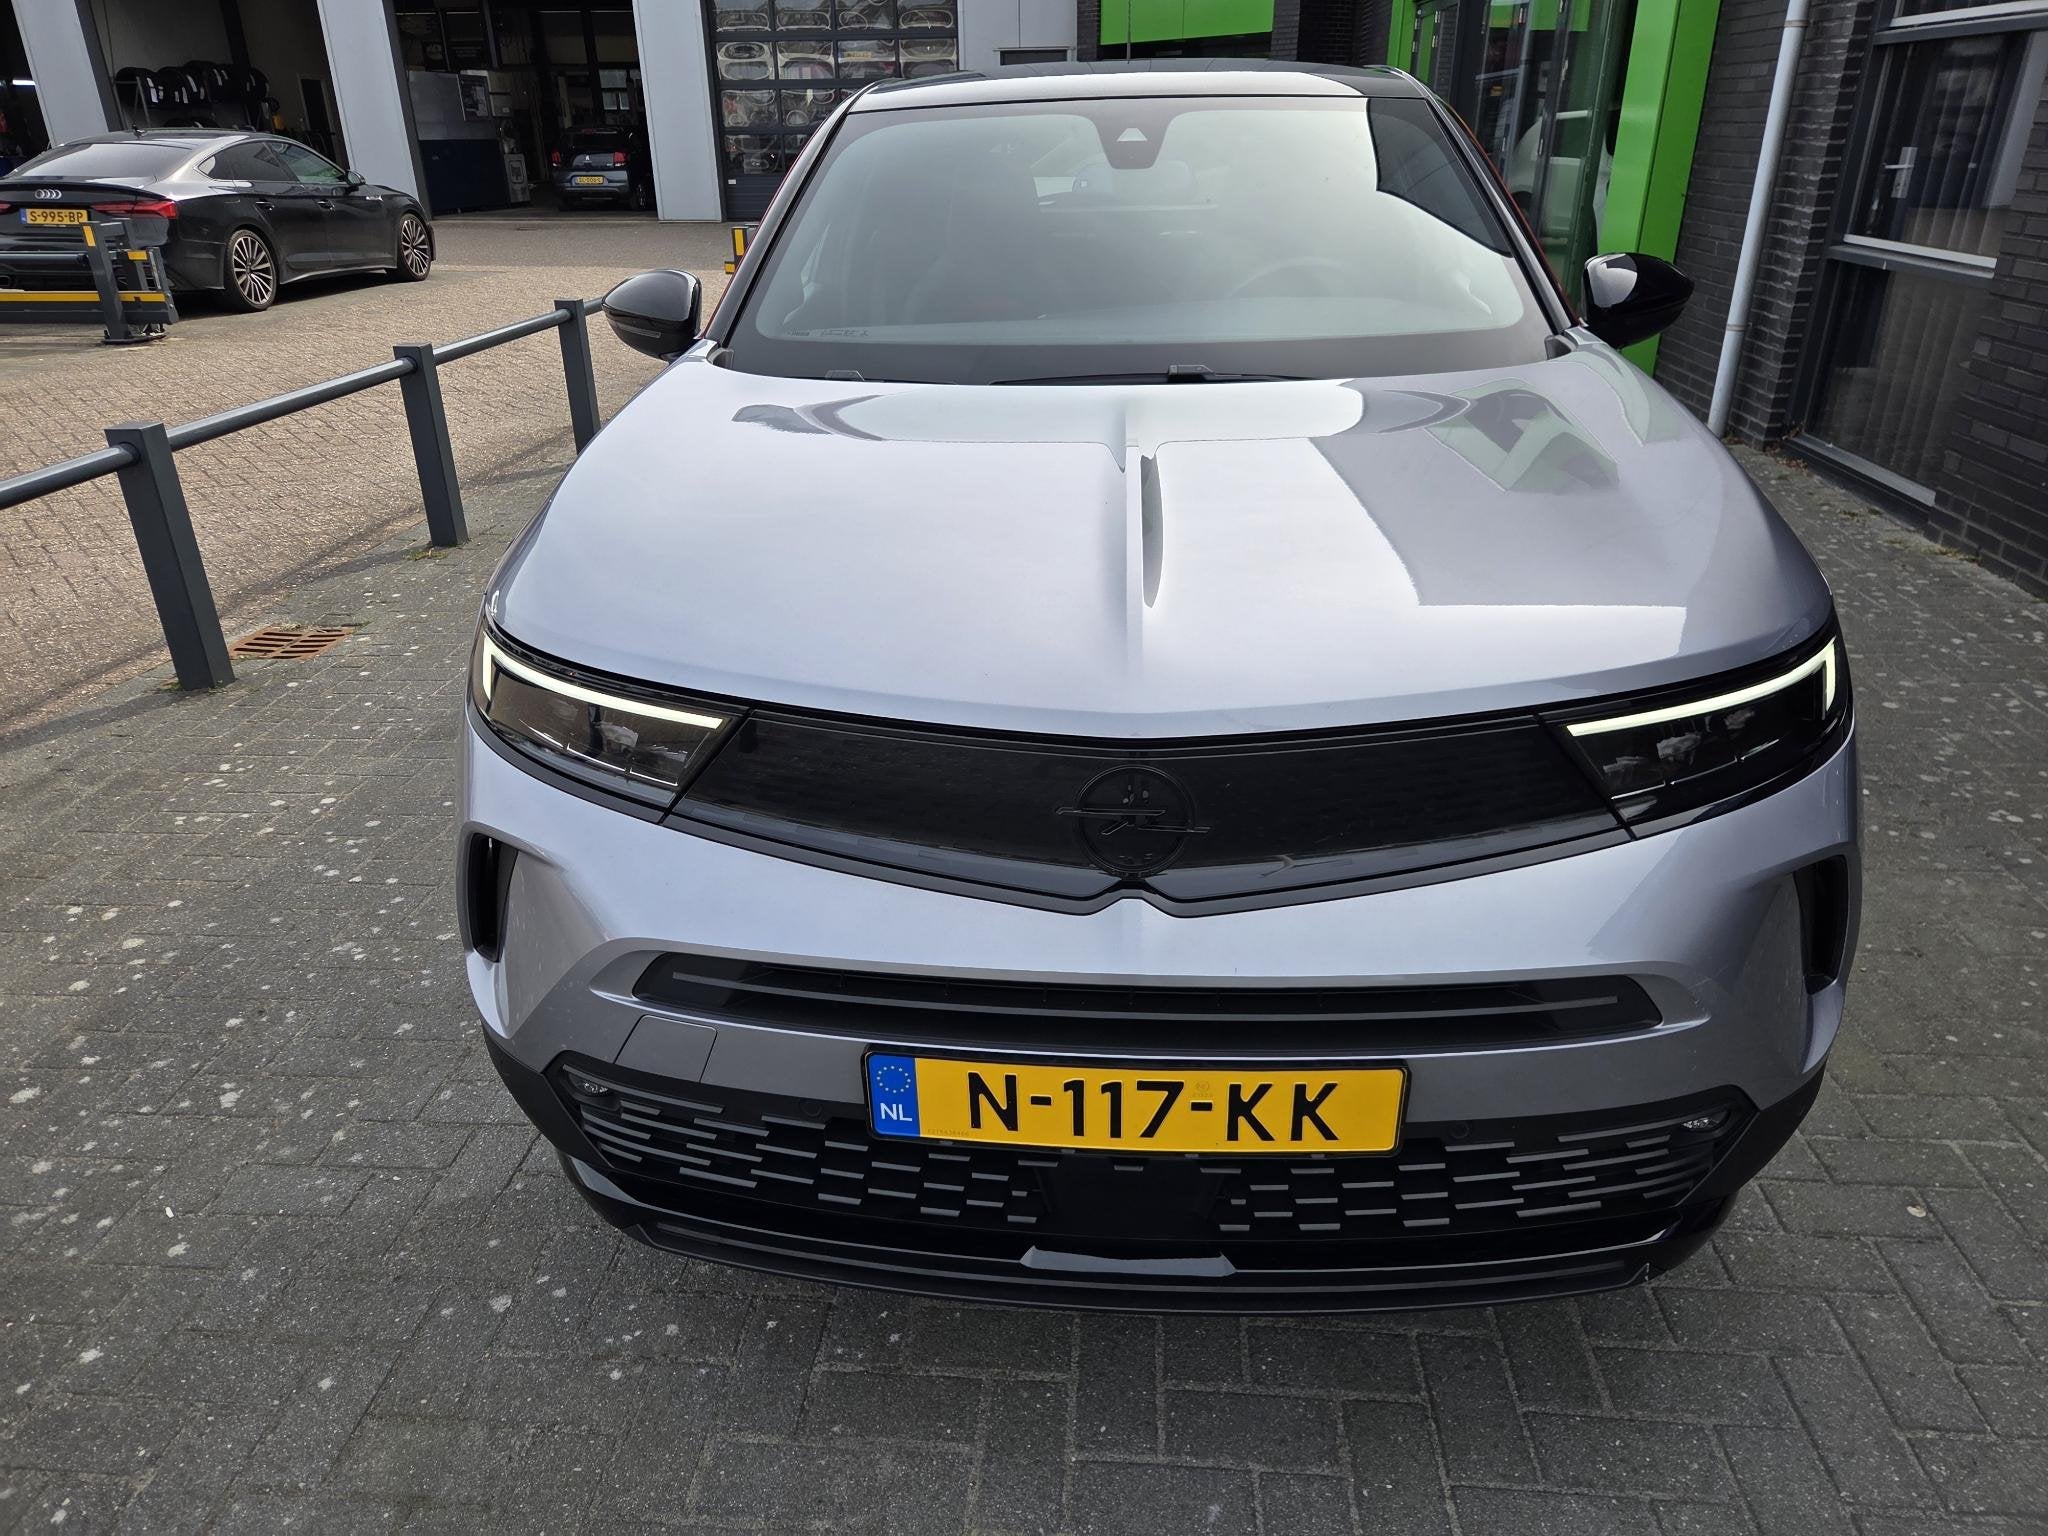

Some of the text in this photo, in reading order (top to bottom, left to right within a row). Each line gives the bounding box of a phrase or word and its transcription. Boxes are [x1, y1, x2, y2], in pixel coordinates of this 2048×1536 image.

[30, 211, 84, 223] S-995-BP
[880, 1103, 913, 1122] NL
[967, 1071, 1340, 1142] N-117-KK
